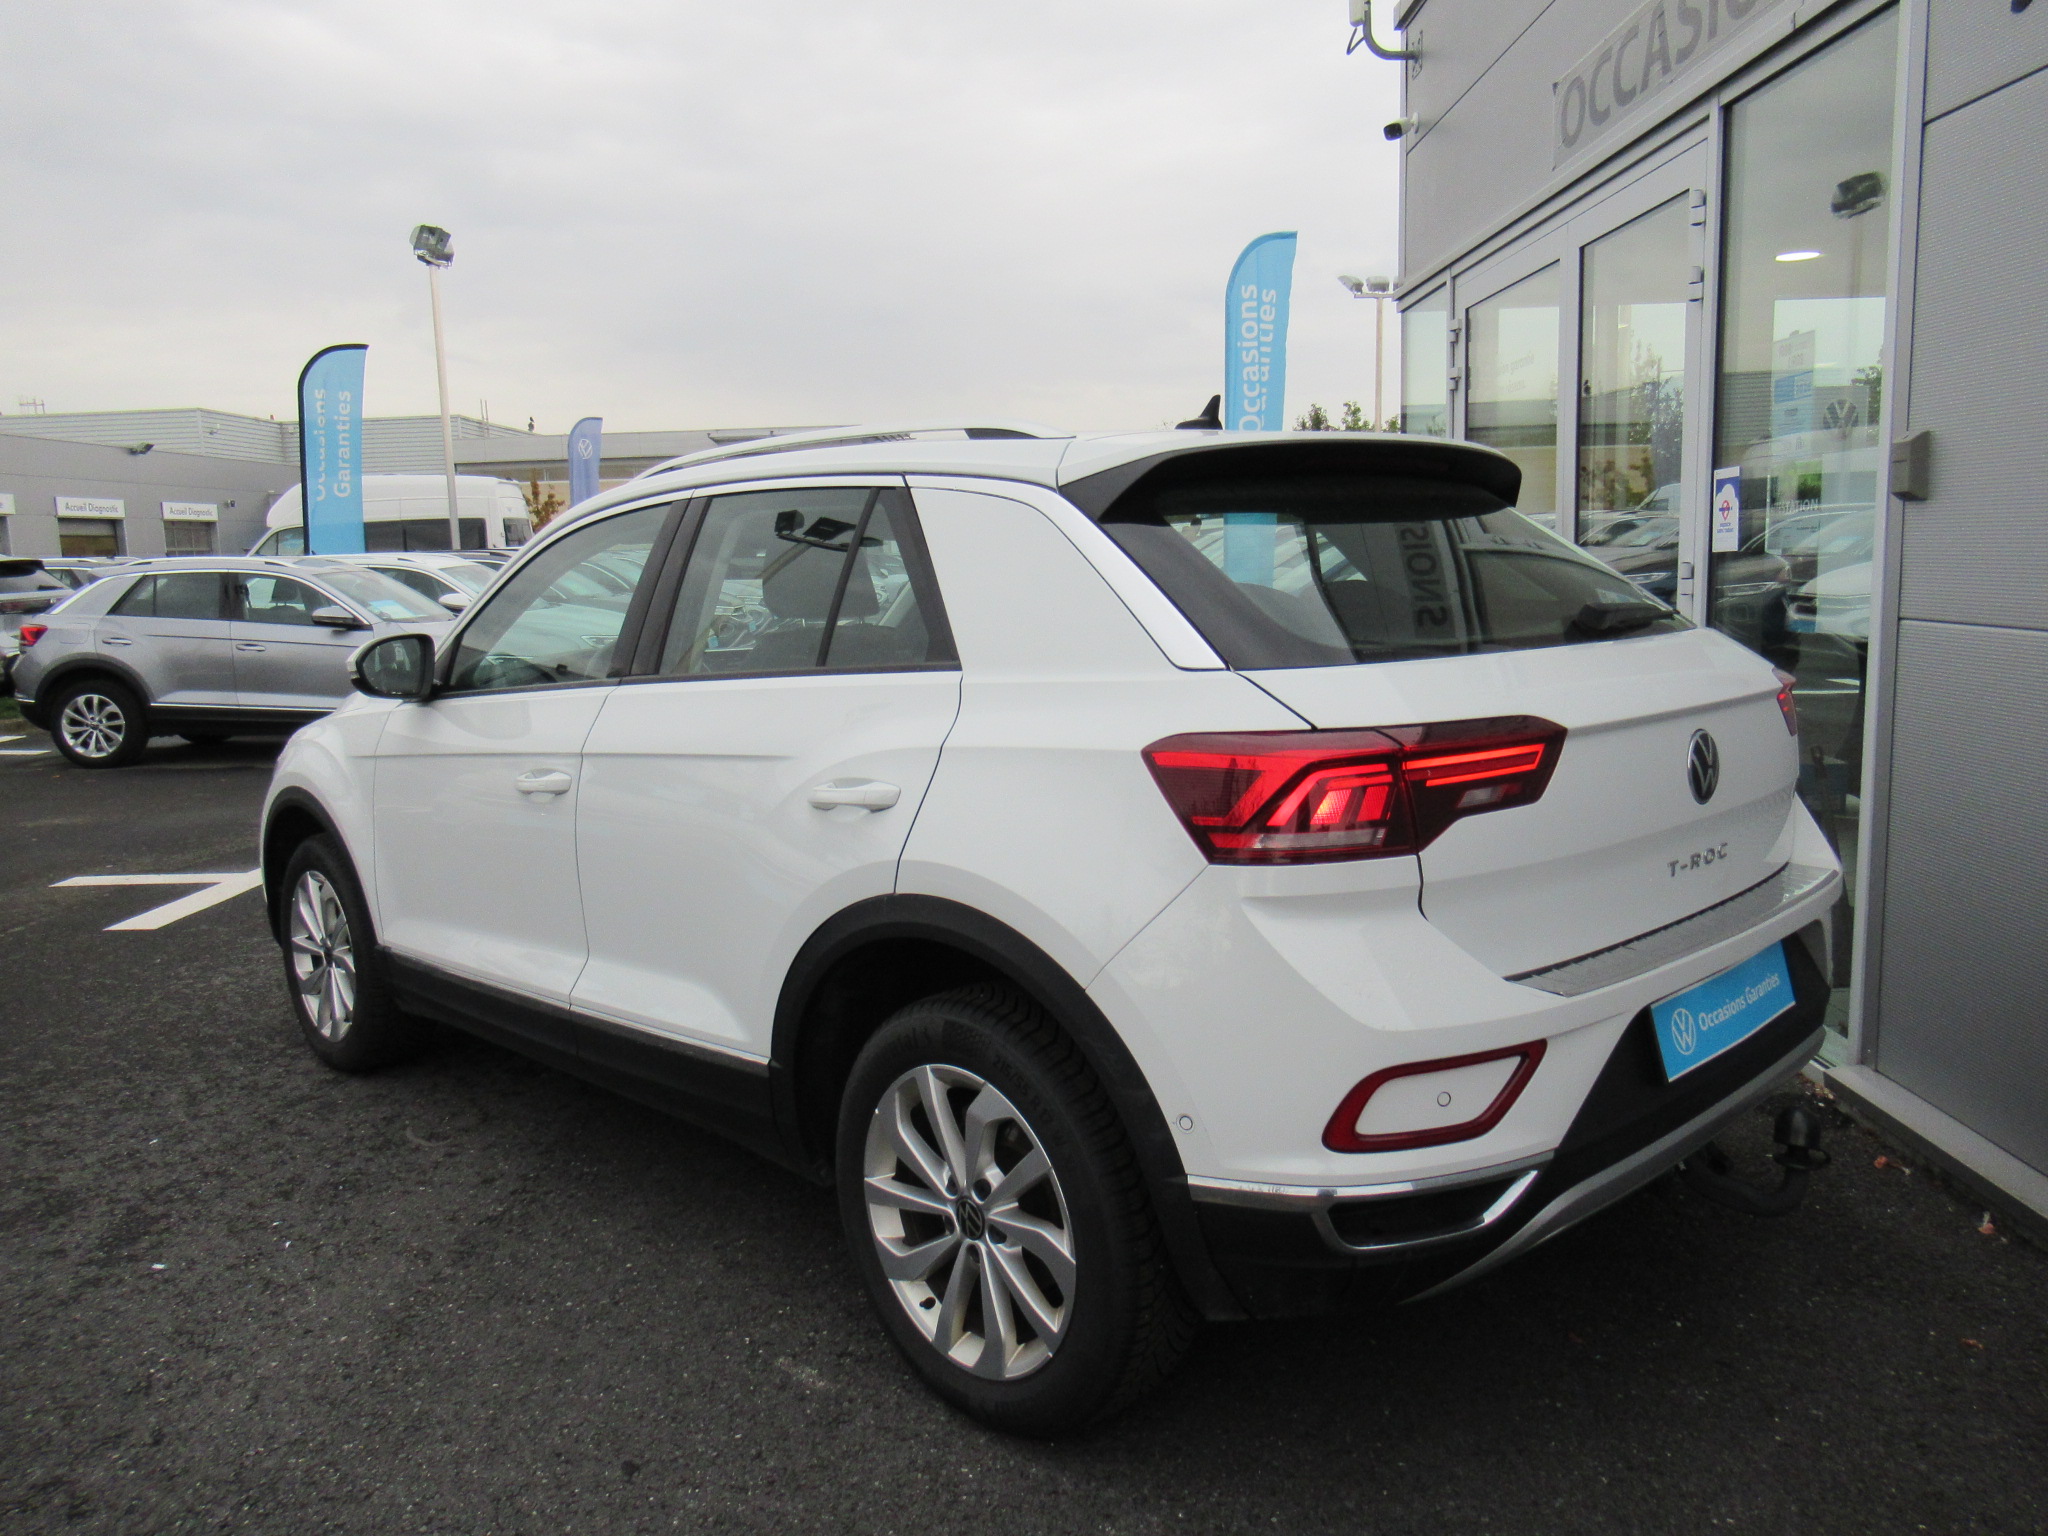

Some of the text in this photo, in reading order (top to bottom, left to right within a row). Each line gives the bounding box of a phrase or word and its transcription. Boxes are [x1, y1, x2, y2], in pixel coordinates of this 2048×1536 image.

[1561, 0, 1756, 149] OCCAS
[1237, 284, 1262, 432] Occasions
[334, 390, 352, 498] Garanties
[65, 502, 118, 515] Accueil Diagnostic
[169, 507, 213, 518] Accueil Diagnostic
[1667, 842, 1728, 877] T-ROC
[1698, 996, 1746, 1031] Occasions
[1745, 973, 1780, 1004] Garanties
